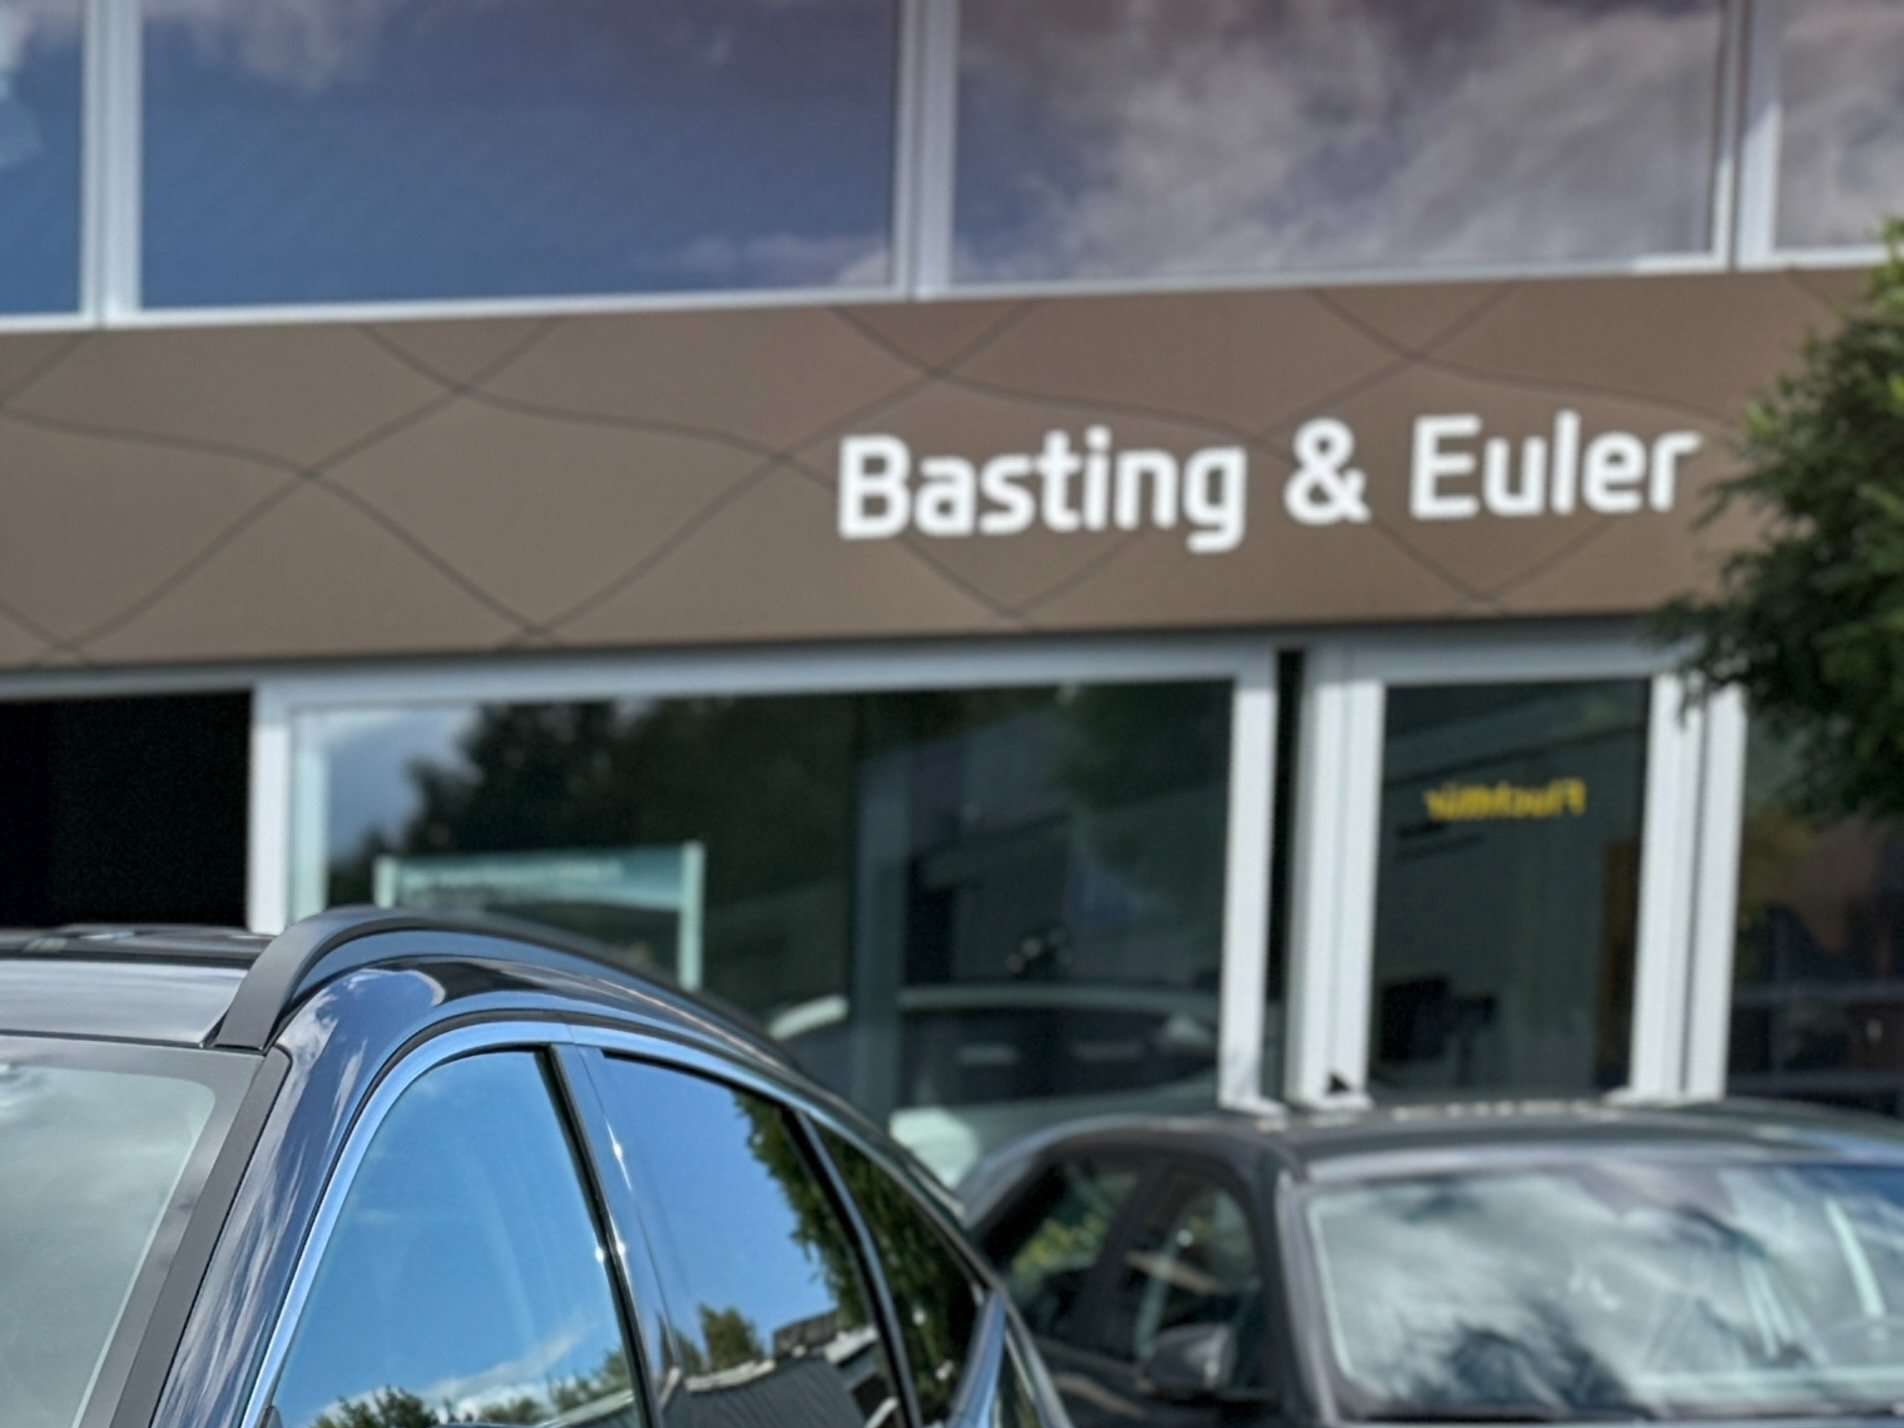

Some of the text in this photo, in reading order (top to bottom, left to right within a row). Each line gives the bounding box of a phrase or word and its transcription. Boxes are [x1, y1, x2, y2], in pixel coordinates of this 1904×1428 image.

[837, 409, 1702, 555] Basting & Euler
